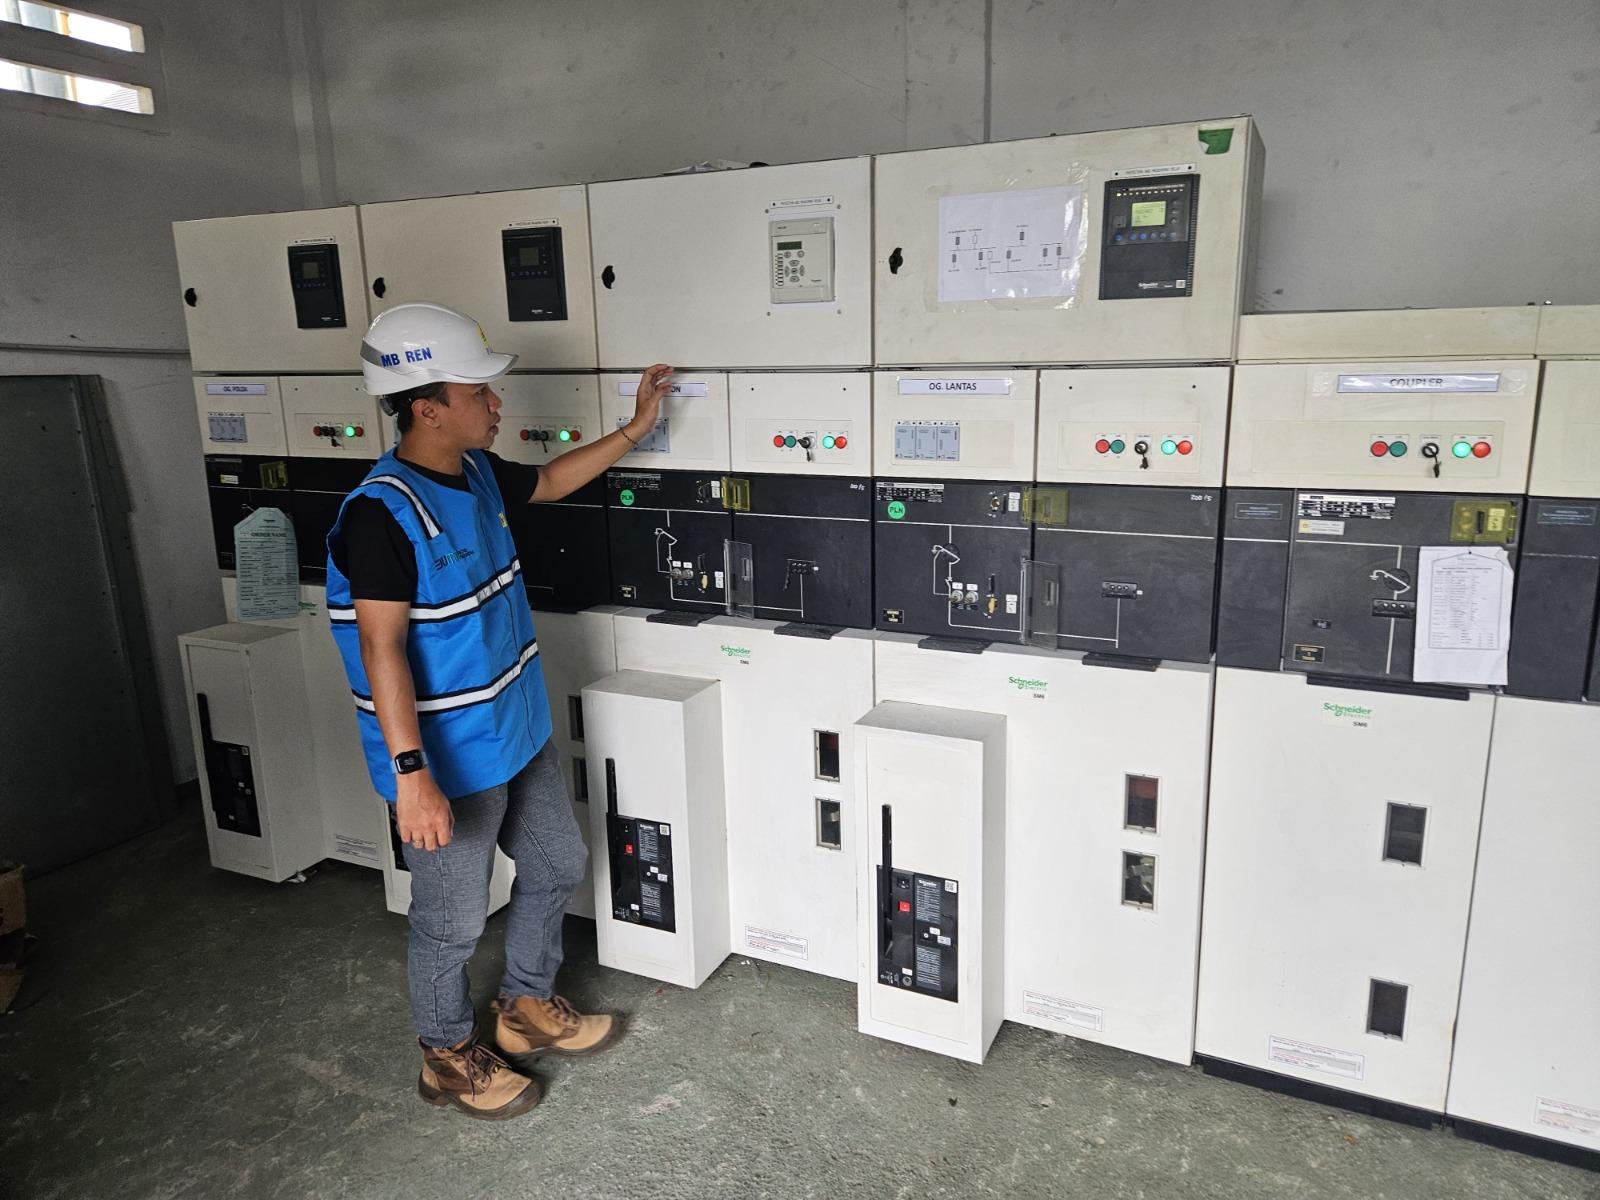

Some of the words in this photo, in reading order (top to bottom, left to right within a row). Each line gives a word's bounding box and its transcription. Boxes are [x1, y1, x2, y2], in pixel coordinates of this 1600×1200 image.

[380, 353, 401, 367] MB
[404, 347, 433, 363] REN
[928, 382, 945, 391] OG.
[945, 382, 977, 391] LANTAS
[1390, 378, 1444, 388] COUPLER
[889, 506, 904, 514] PLN
[720, 645, 752, 657] Schneider
[1008, 676, 1049, 689] Schneider
[1323, 702, 1374, 717] Schneider
